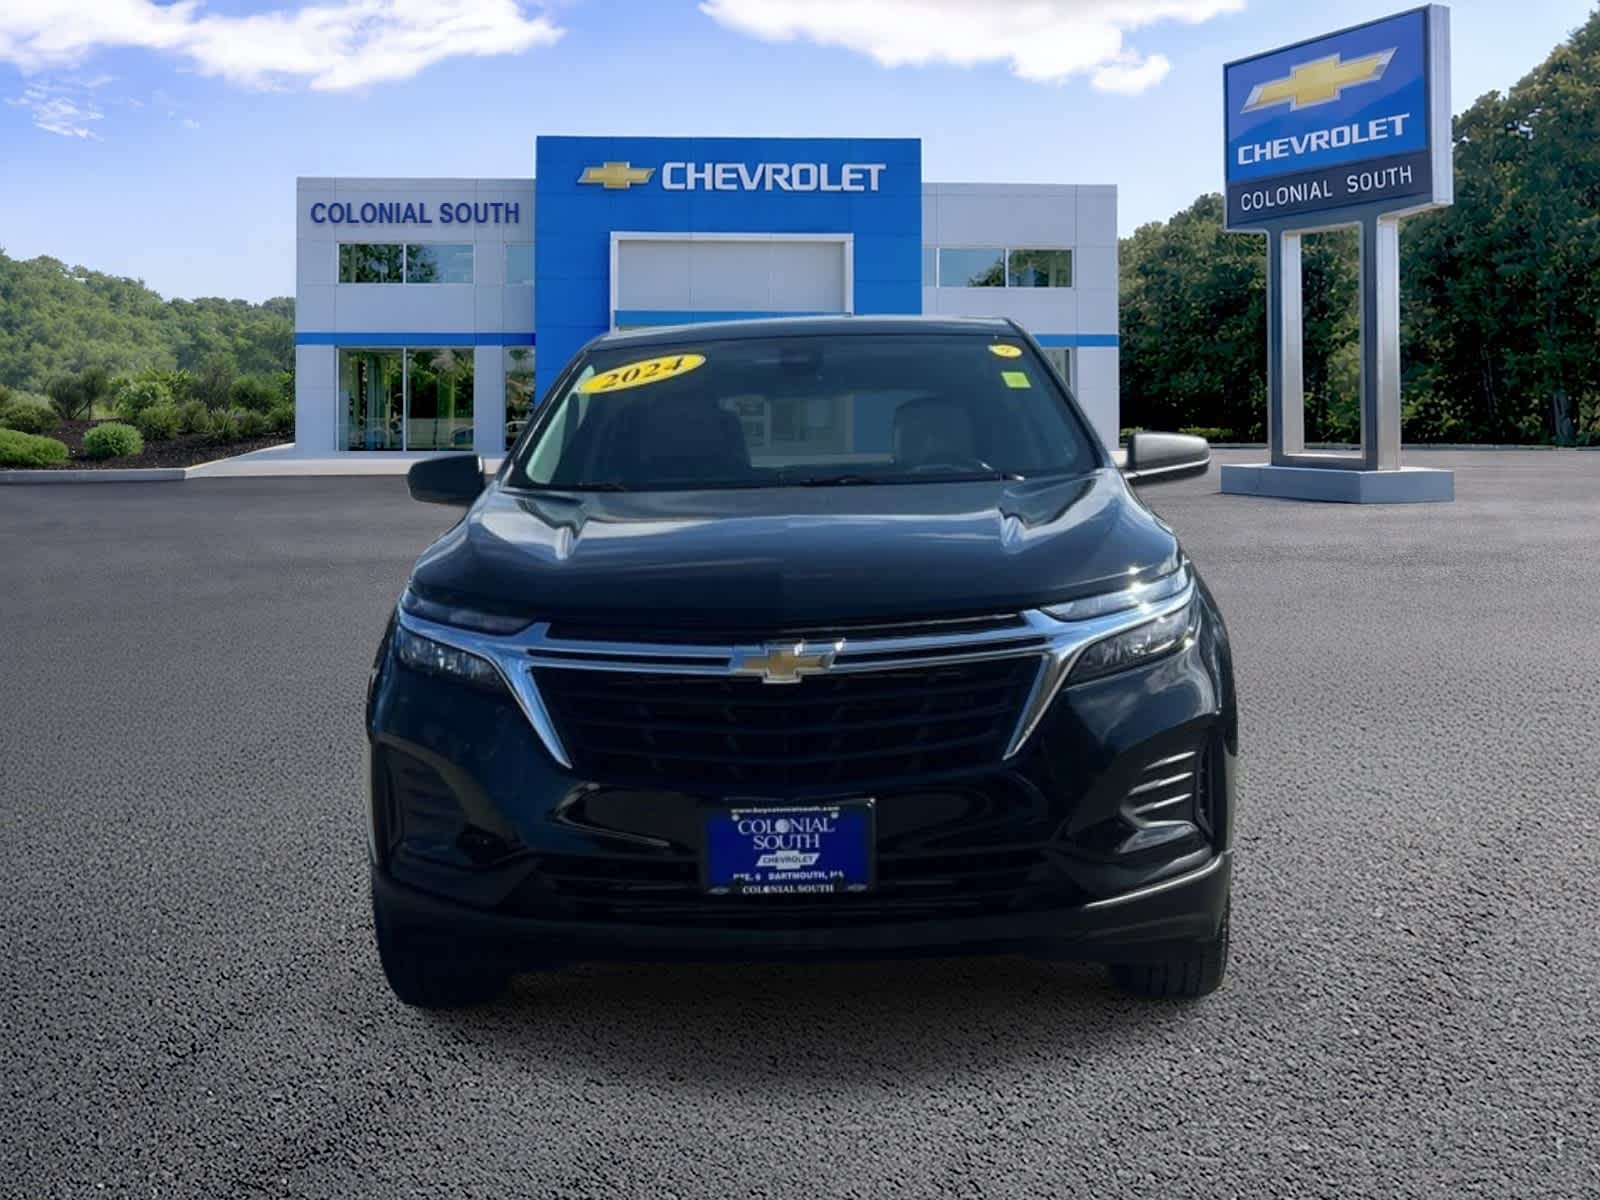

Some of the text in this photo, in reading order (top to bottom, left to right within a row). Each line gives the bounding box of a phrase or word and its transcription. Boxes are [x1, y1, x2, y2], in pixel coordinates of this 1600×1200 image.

[1237, 113, 1410, 165] CHEVROLET
[662, 162, 887, 192] CHEVROLET
[1241, 165, 1412, 211] COLONIAL SOUTH
[310, 202, 520, 224] COLONIAL SOUTH
[601, 356, 684, 388] 2024
[738, 817, 836, 835] COLONIAL
[753, 833, 821, 850] SOUTH
[762, 855, 814, 864] CHEVROLET
[768, 871, 828, 881] DARTMOUTH,
[742, 884, 834, 895] COLONIAL SOUTH
